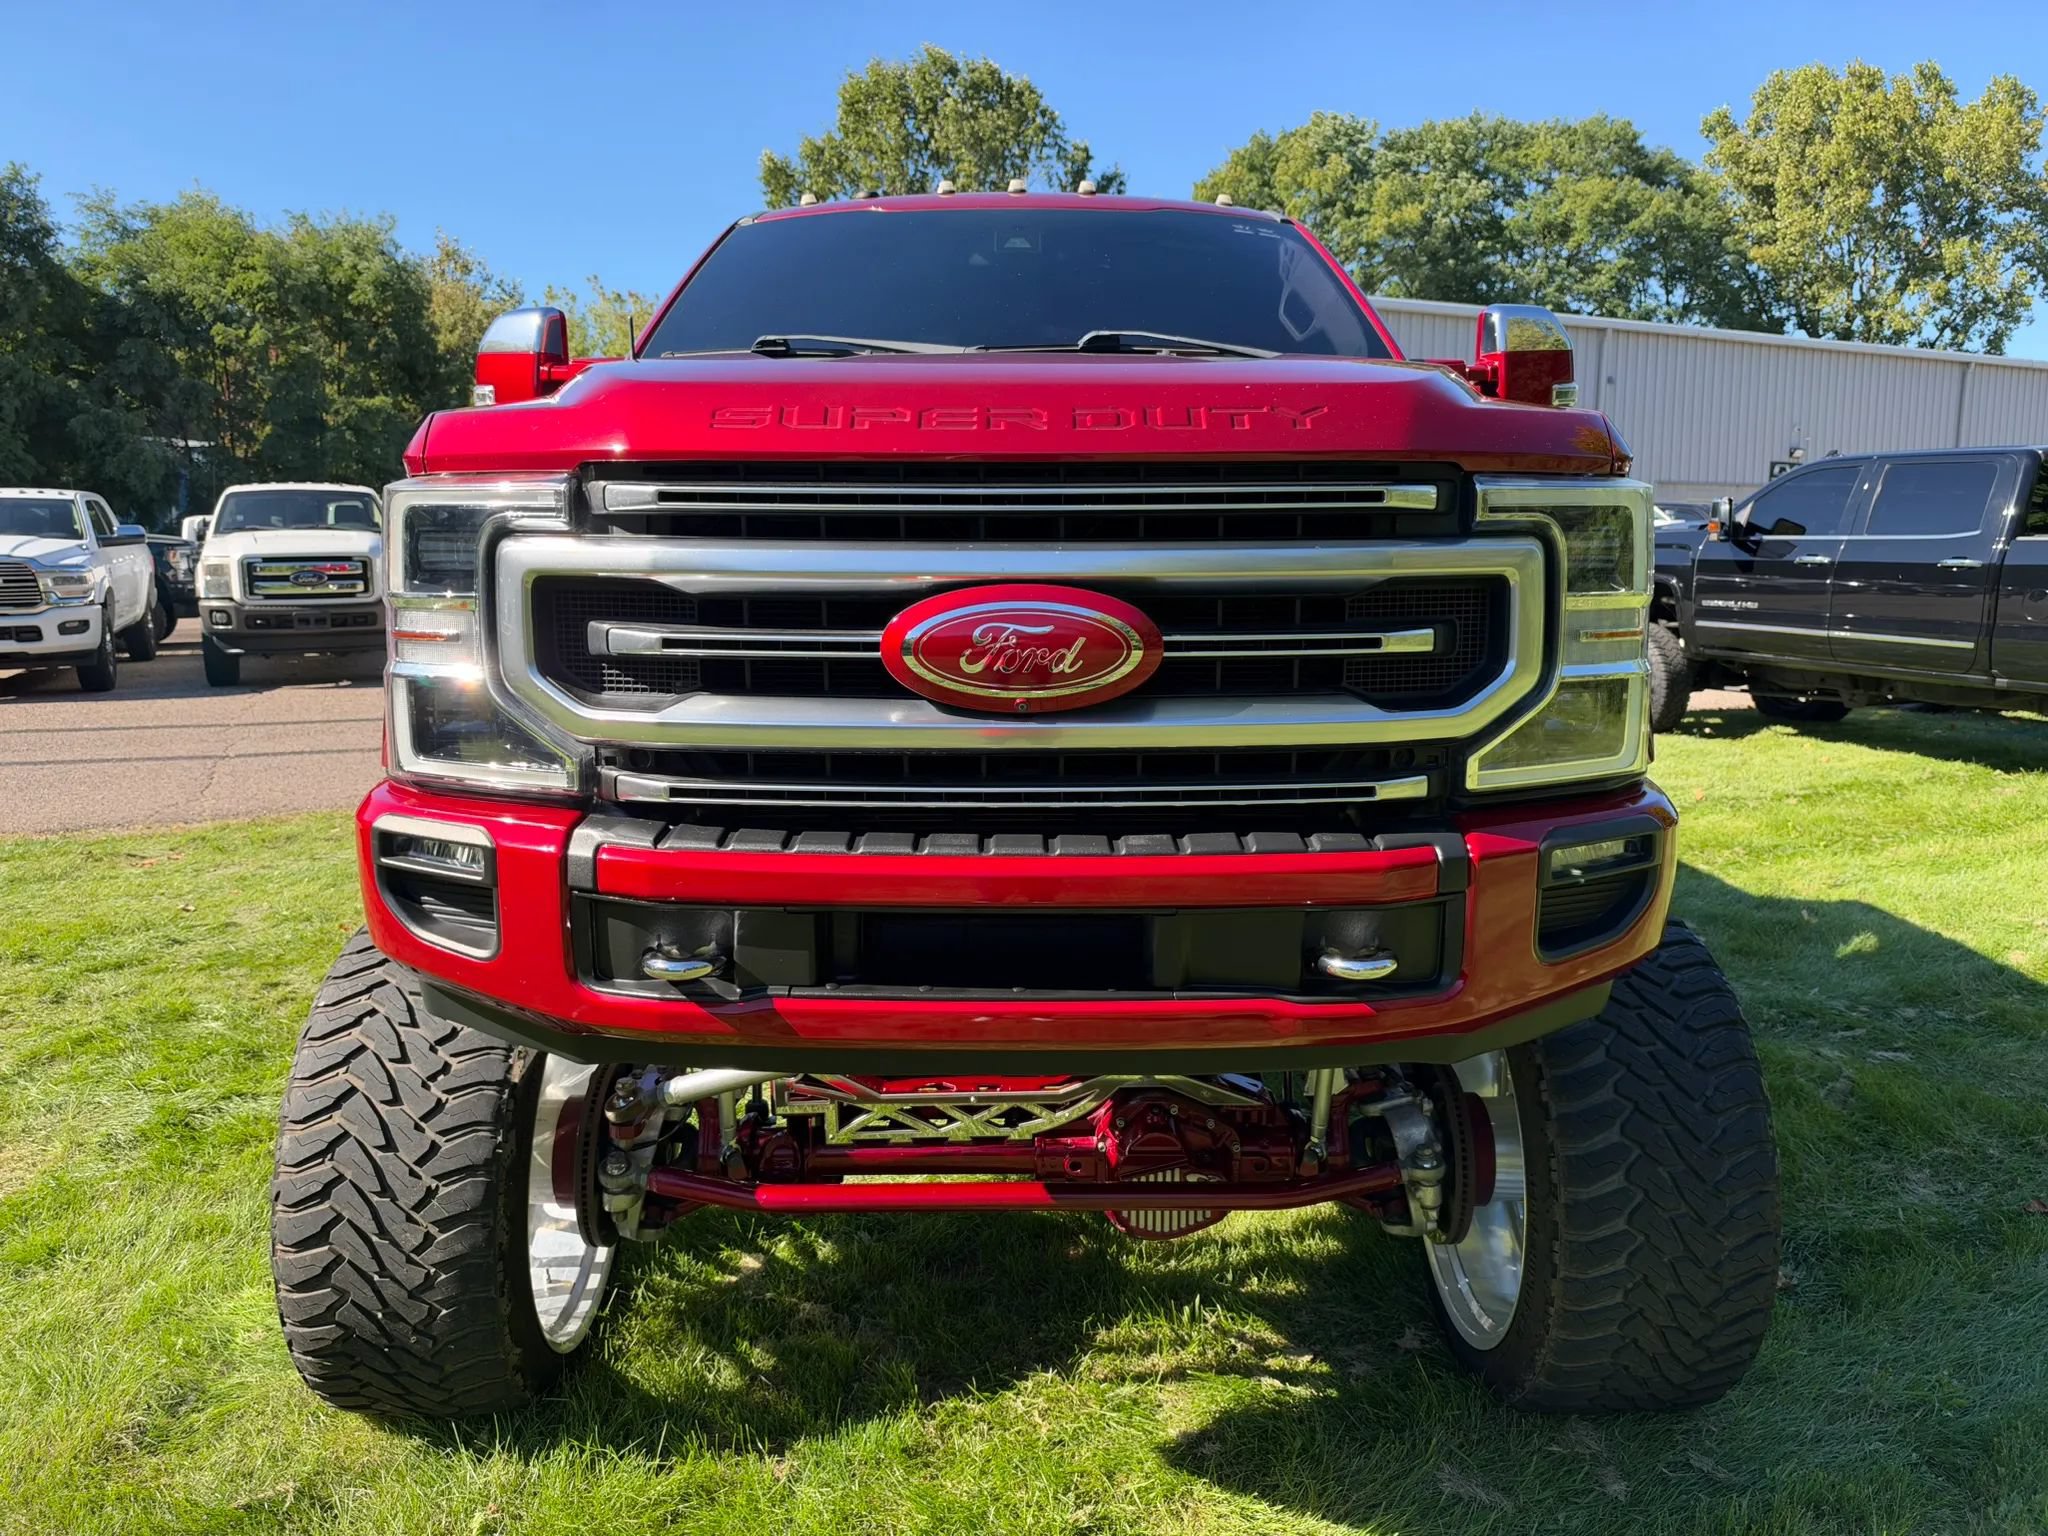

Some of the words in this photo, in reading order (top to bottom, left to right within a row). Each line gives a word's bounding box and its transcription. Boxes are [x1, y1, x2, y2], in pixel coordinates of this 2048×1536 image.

[709, 405, 1048, 431] SUPER
[1071, 405, 1328, 431] DUTY
[959, 622, 1087, 674] Ford
